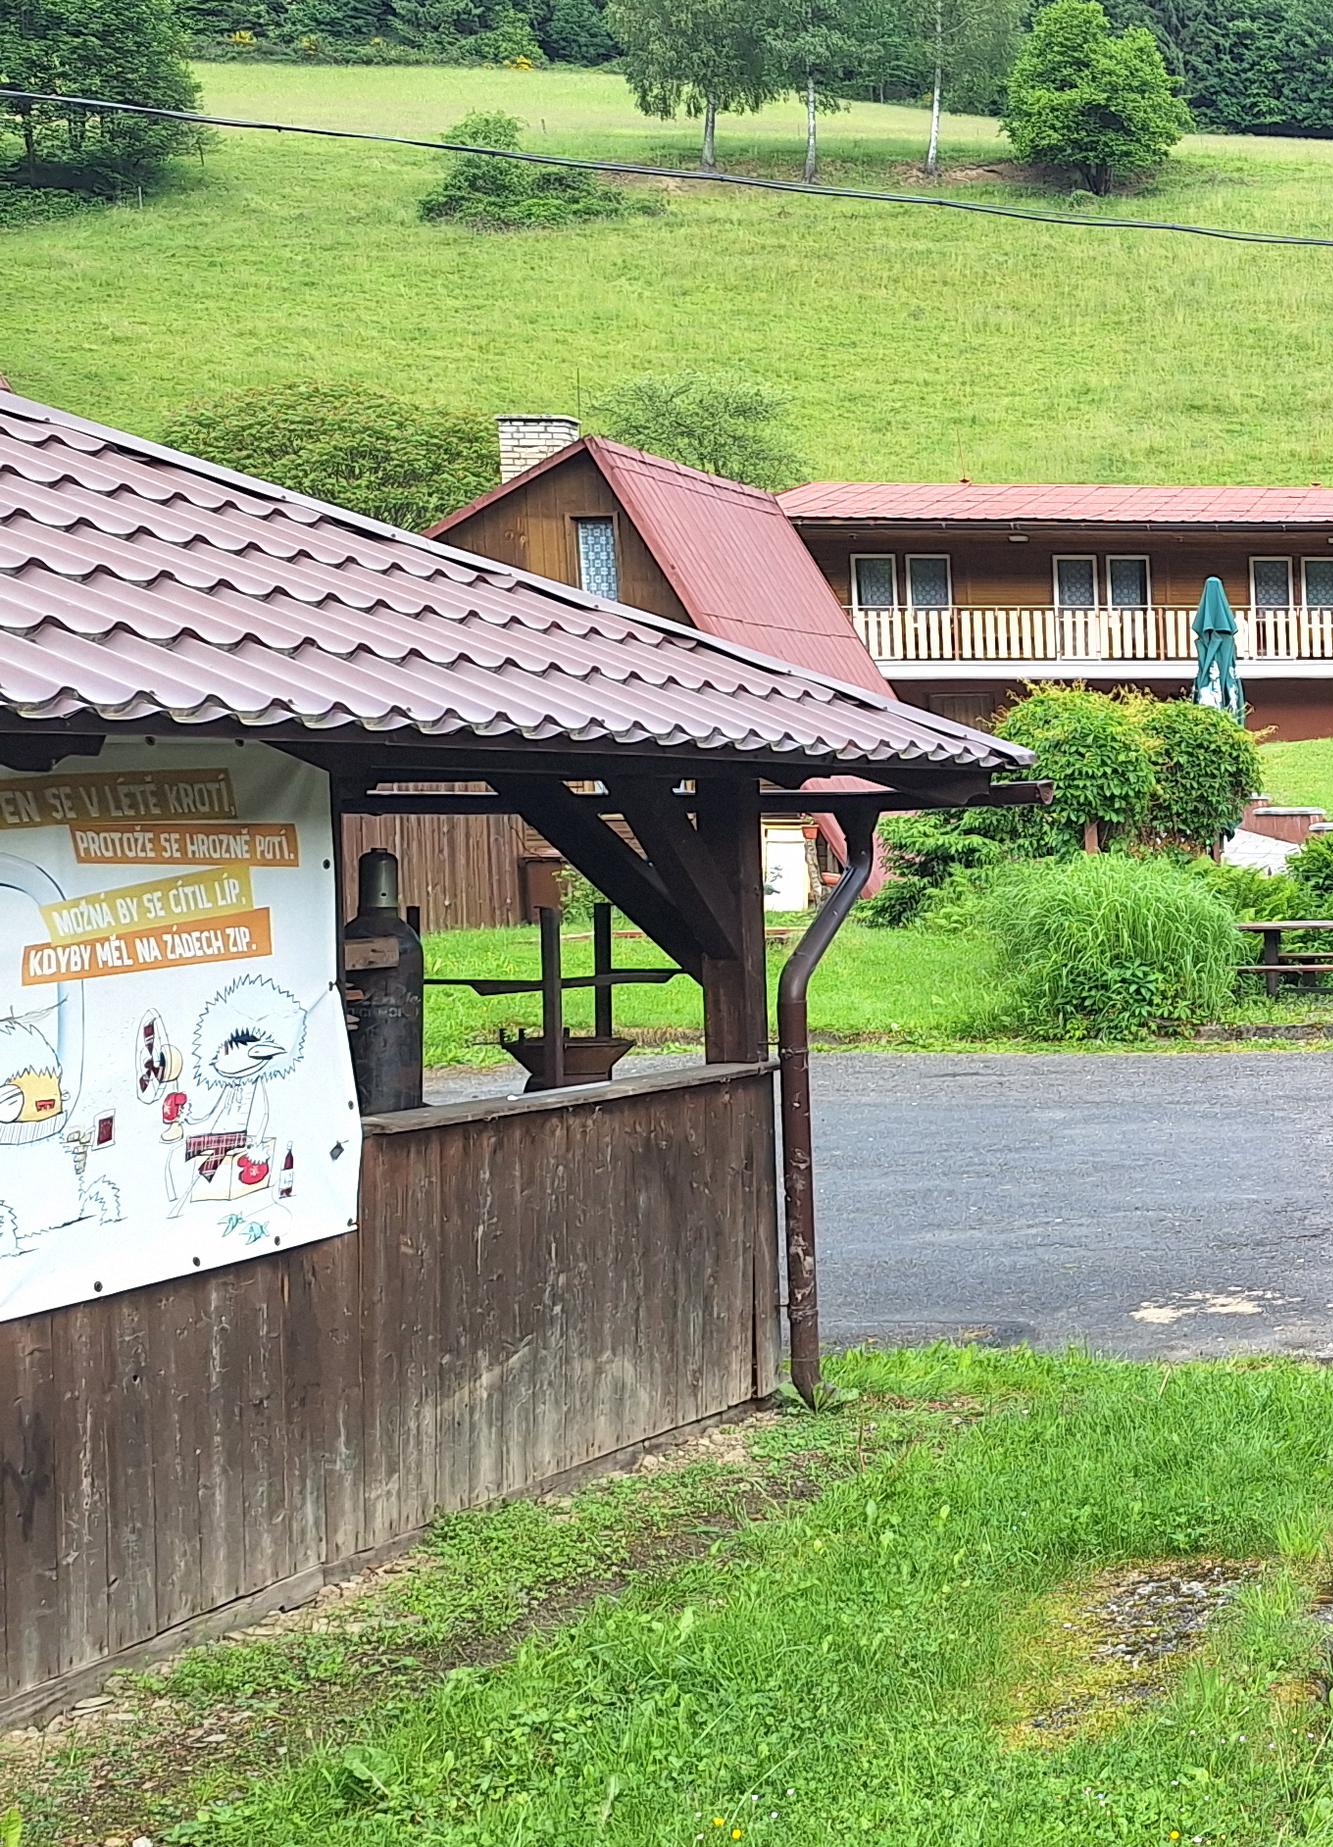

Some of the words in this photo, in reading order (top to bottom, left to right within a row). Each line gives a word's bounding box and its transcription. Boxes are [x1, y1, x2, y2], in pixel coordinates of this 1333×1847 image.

[43, 785, 78, 820] SE
[79, 786, 100, 818] V
[104, 775, 162, 818] LÉTĚ
[163, 773, 237, 817] KROTÍ,
[75, 824, 156, 859] PROTOŽE
[159, 832, 182, 859] SE
[185, 827, 251, 860] HROZNĚ
[255, 827, 295, 860] POTÍ.
[52, 892, 116, 937] MOŽNÁ
[115, 897, 139, 925] BY
[142, 891, 167, 920] SE
[168, 880, 213, 915] CÍTIL
[29, 944, 92, 977] KDYBY
[95, 933, 134, 970] MĚL
[134, 936, 163, 964] NA
[162, 924, 225, 961] ZÁDECH
[225, 926, 257, 954] ZIP.
